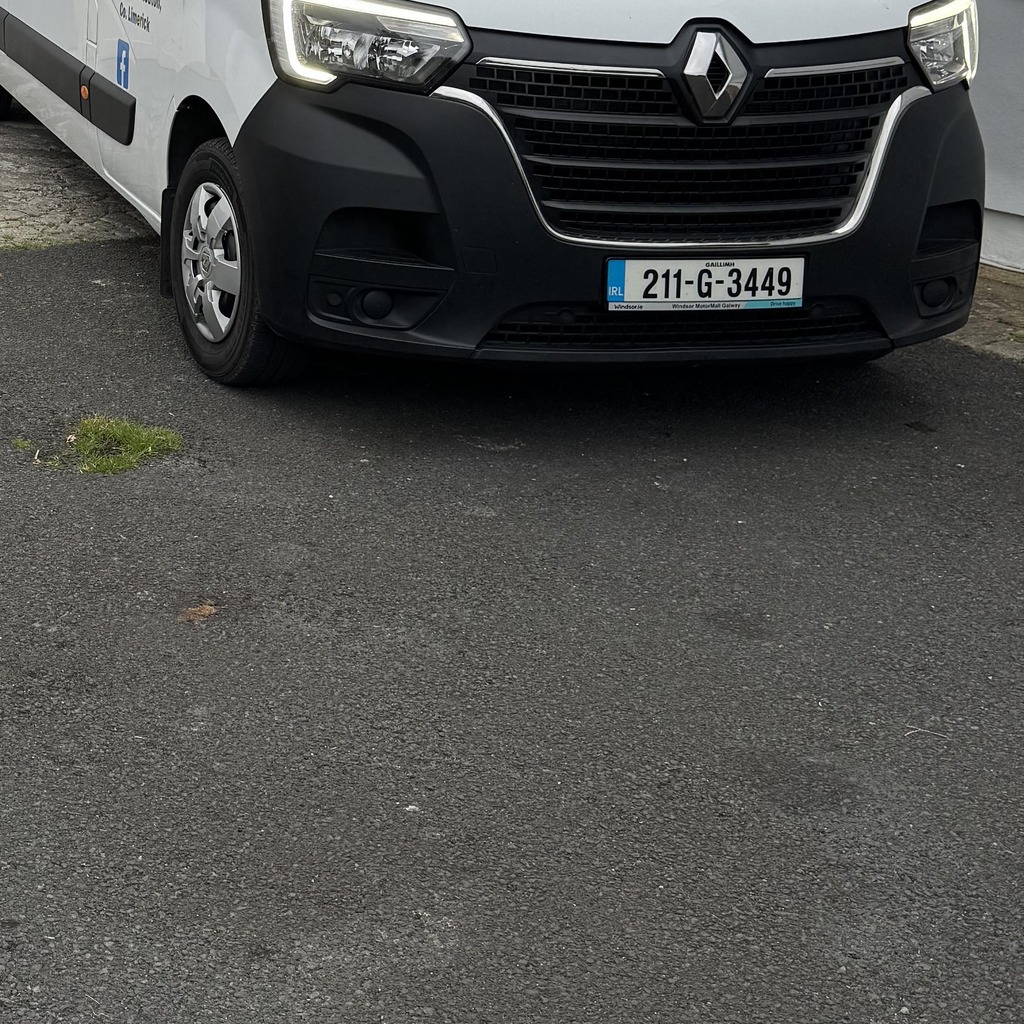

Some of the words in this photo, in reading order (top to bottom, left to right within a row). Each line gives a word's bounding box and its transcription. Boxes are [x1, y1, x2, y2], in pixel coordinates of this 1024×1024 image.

[128, 5, 151, 33] Limerick
[608, 286, 624, 297] IRL
[642, 267, 792, 299] 211-G-3449
